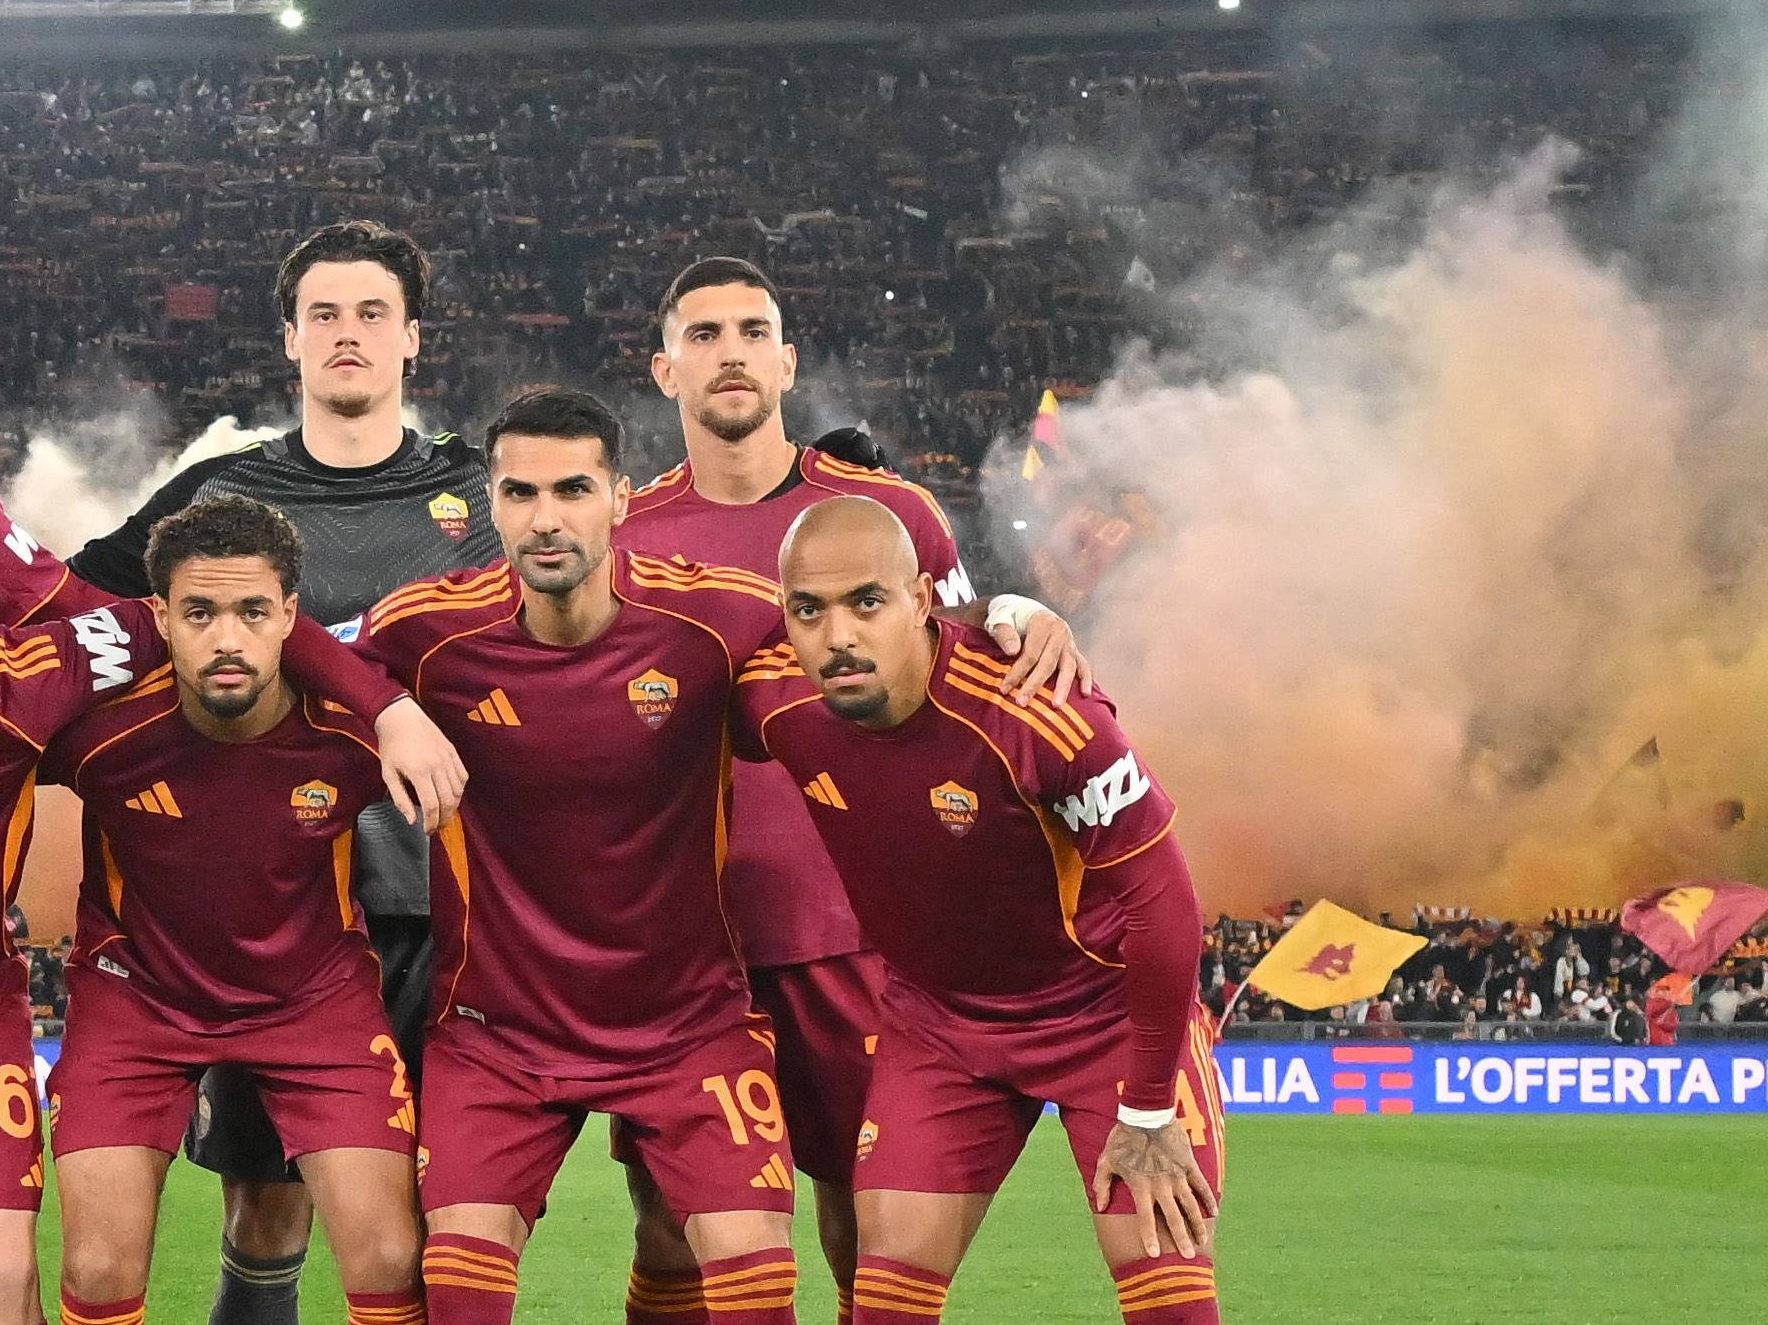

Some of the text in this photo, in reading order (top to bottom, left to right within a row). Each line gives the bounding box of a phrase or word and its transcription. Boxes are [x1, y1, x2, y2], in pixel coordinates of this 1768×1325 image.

[636, 703, 672, 715] ROMA
[296, 809, 329, 819] ROMA
[940, 811, 975, 823] ROMA
[1435, 1058, 1720, 1104] L'OFFERTA
[702, 1069, 784, 1145] 19
